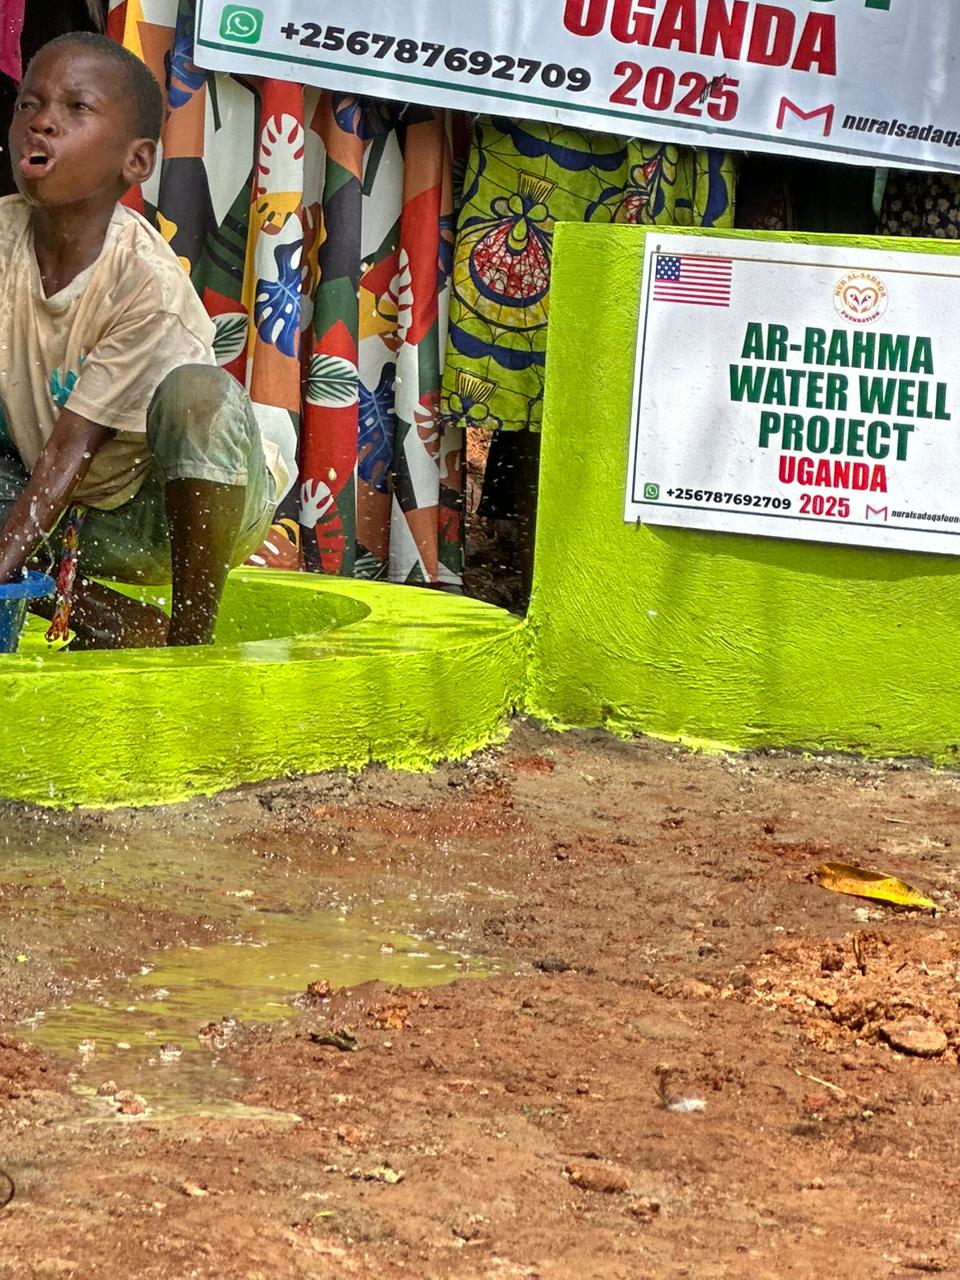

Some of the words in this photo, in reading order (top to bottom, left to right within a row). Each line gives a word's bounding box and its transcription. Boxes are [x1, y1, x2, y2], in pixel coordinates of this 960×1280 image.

[280, 21, 592, 93] +256787692709
[609, 60, 740, 123] 2025
[741, 322, 934, 375] AR-RAHMA
[729, 364, 849, 411] WATER
[859, 374, 951, 421] WELL
[758, 410, 915, 461] PROJECT
[778, 455, 888, 493] UGANDA
[666, 486, 792, 511] +256787692709
[799, 493, 850, 518] 2025
